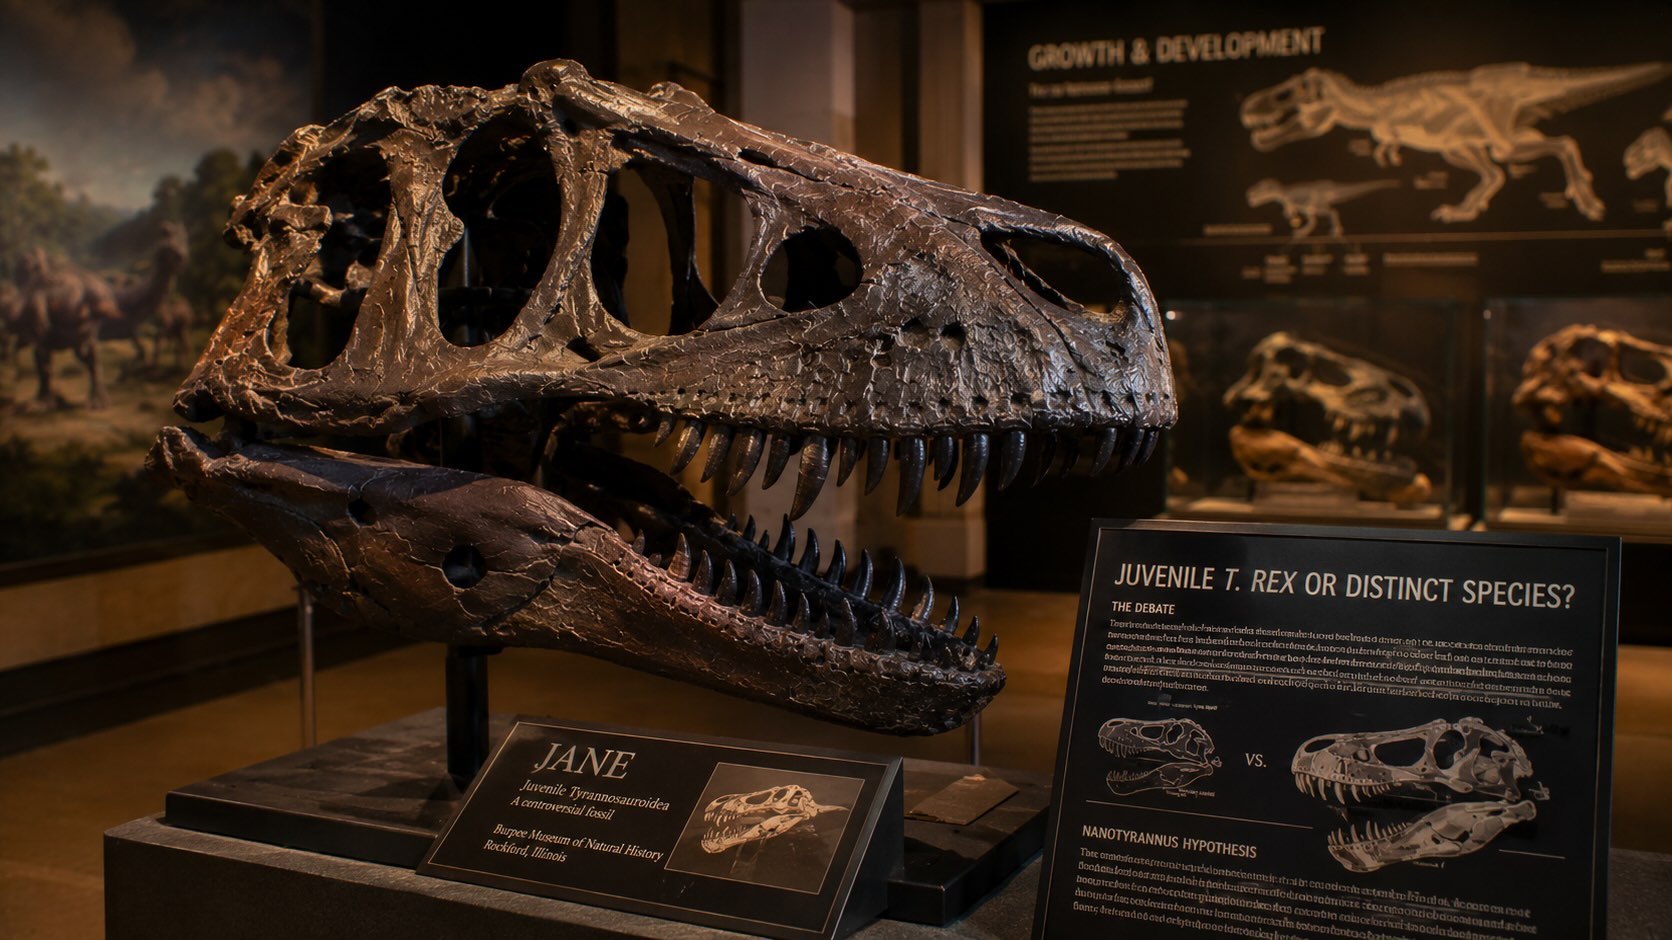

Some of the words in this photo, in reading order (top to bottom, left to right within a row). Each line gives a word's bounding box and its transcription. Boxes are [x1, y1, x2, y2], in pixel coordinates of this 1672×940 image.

[1028, 40, 1124, 70] GROWTH
[1131, 38, 1150, 65] &
[1156, 26, 1325, 63] DEVELOPMENT
[1114, 563, 1215, 590] JUVENILE
[1225, 568, 1240, 591] T.
[1251, 569, 1298, 594] REX
[1305, 572, 1337, 597] OR
[1346, 573, 1453, 602] DISTINCT
[1462, 579, 1576, 609] SPECIES?
[1111, 601, 1132, 612] THE
[1135, 603, 1175, 615] DEBATE
[531, 743, 636, 779] JANE
[510, 796, 520, 806] A
[522, 798, 585, 816] controversial
[585, 806, 615, 820] fossil
[520, 779, 567, 796] Juvenile
[569, 785, 670, 811] Tyrannosauroidea
[484, 840, 529, 858] Rockford,
[531, 846, 567, 862] Illinois
[493, 824, 528, 839] Burpee
[528, 829, 571, 845] Museum
[572, 837, 586, 848] of
[585, 838, 623, 854] Natural
[624, 845, 663, 862] History
[1082, 825, 1179, 848] NANOTYRANNUS
[1182, 837, 1257, 858] HYPOTHESIS
